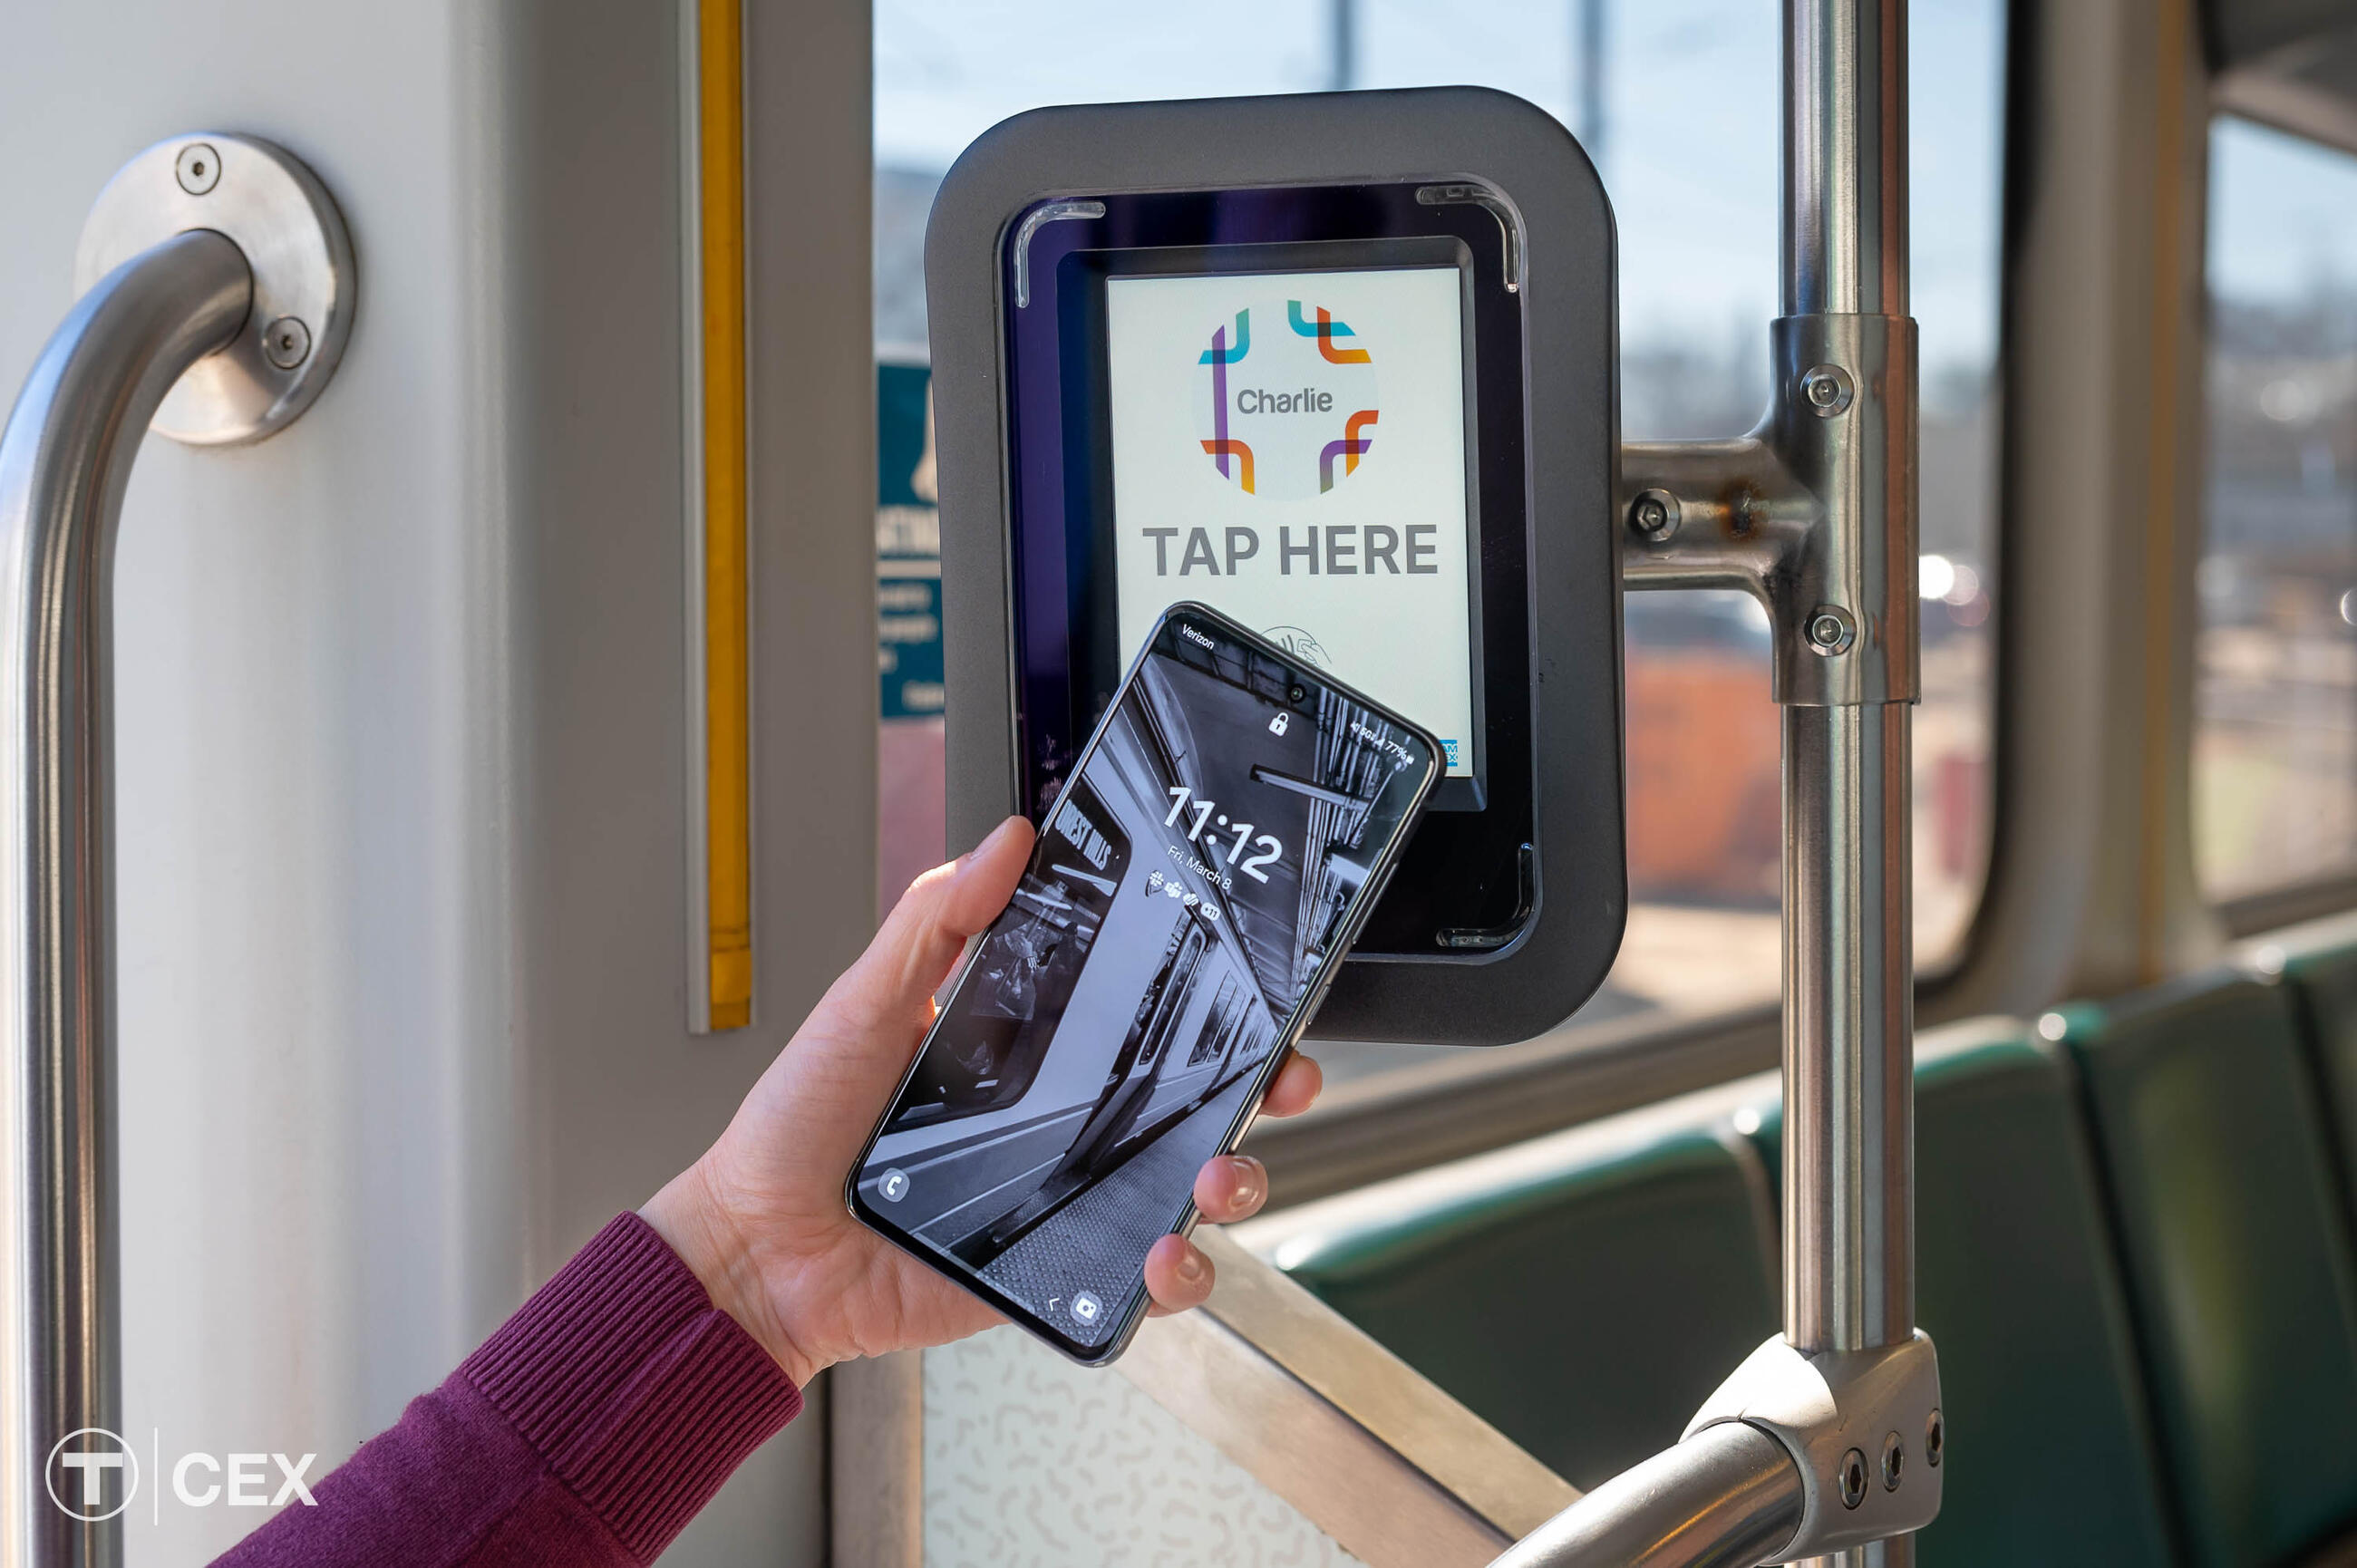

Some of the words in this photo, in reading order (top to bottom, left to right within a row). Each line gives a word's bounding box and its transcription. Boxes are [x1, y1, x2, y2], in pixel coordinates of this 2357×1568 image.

[1237, 388, 1334, 414] Charlie
[1142, 526, 1260, 576] TAP
[1279, 524, 1439, 576] HERE
[1181, 623, 1215, 651] Verizon
[1384, 740, 1408, 760] 77%
[1164, 786, 1283, 885] 11:12
[1167, 845, 1185, 864] Fri,
[1186, 856, 1221, 886] March
[1221, 877, 1233, 891] 8
